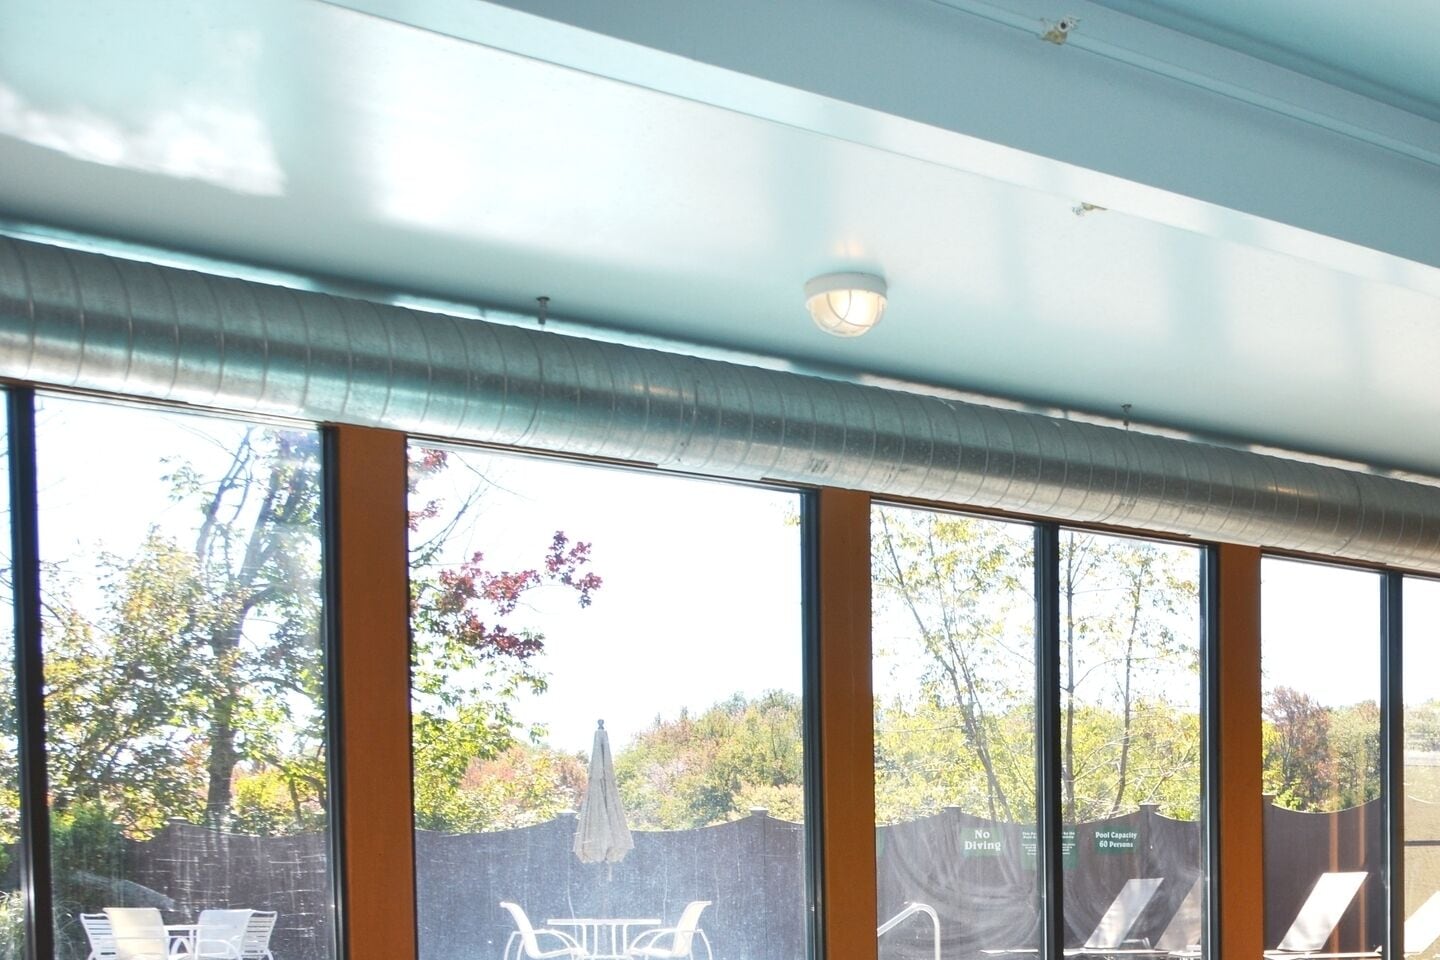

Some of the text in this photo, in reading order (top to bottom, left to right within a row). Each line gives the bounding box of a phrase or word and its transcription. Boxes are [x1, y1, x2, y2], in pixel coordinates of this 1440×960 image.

[975, 829, 991, 839] No
[1095, 831, 1137, 840] Pool Capacity
[964, 840, 1002, 852] Diving
[1099, 840, 1134, 848] 60 Persons
